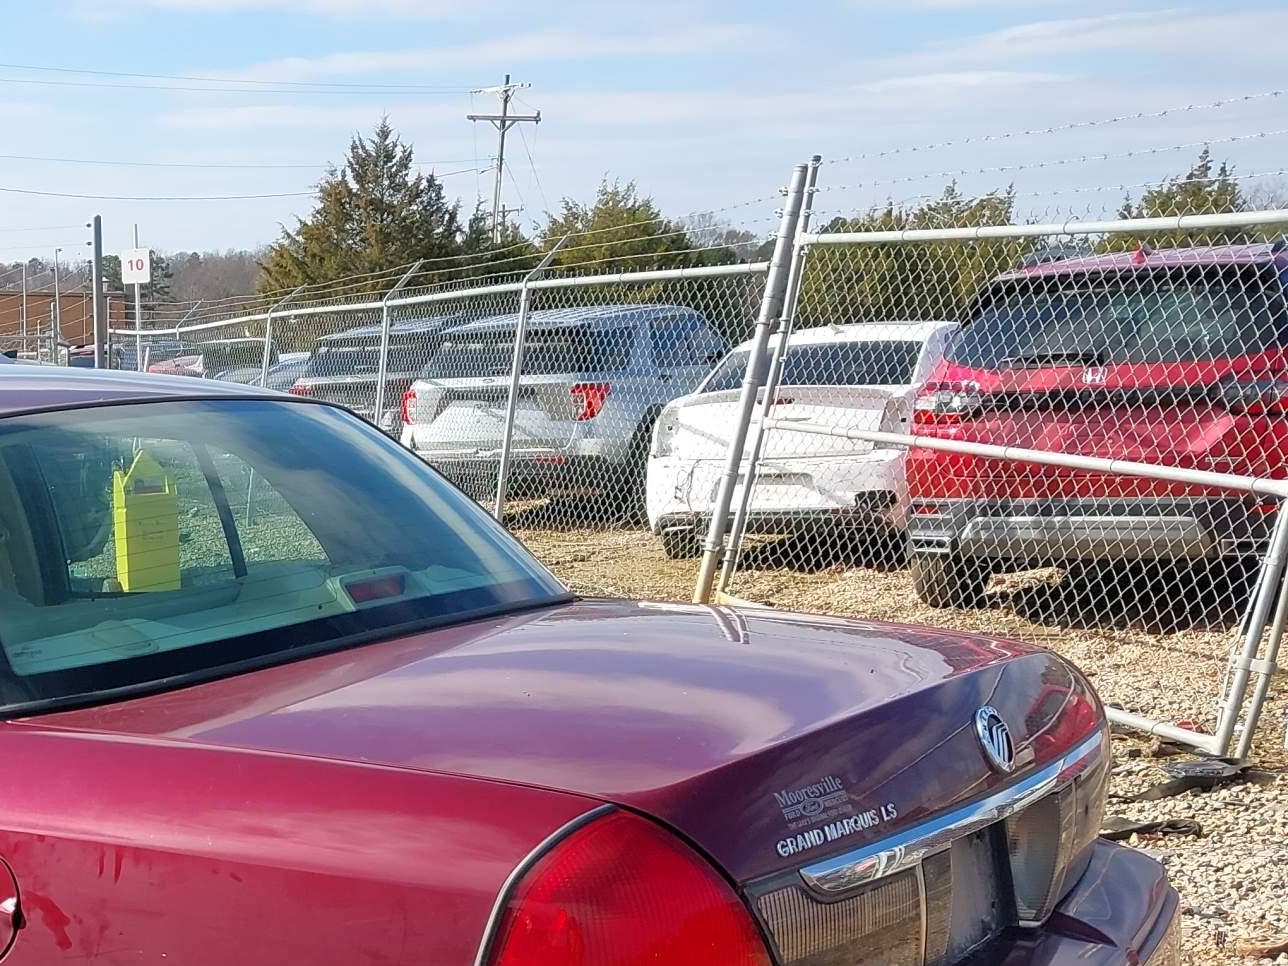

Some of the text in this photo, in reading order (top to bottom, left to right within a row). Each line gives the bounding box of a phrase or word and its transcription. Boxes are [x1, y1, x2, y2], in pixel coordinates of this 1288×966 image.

[127, 258, 144, 271] 10
[774, 776, 843, 807] Mooresville
[776, 828, 825, 857] GRAND
[823, 808, 880, 842] MARQUIS
[880, 803, 898, 822] LS
